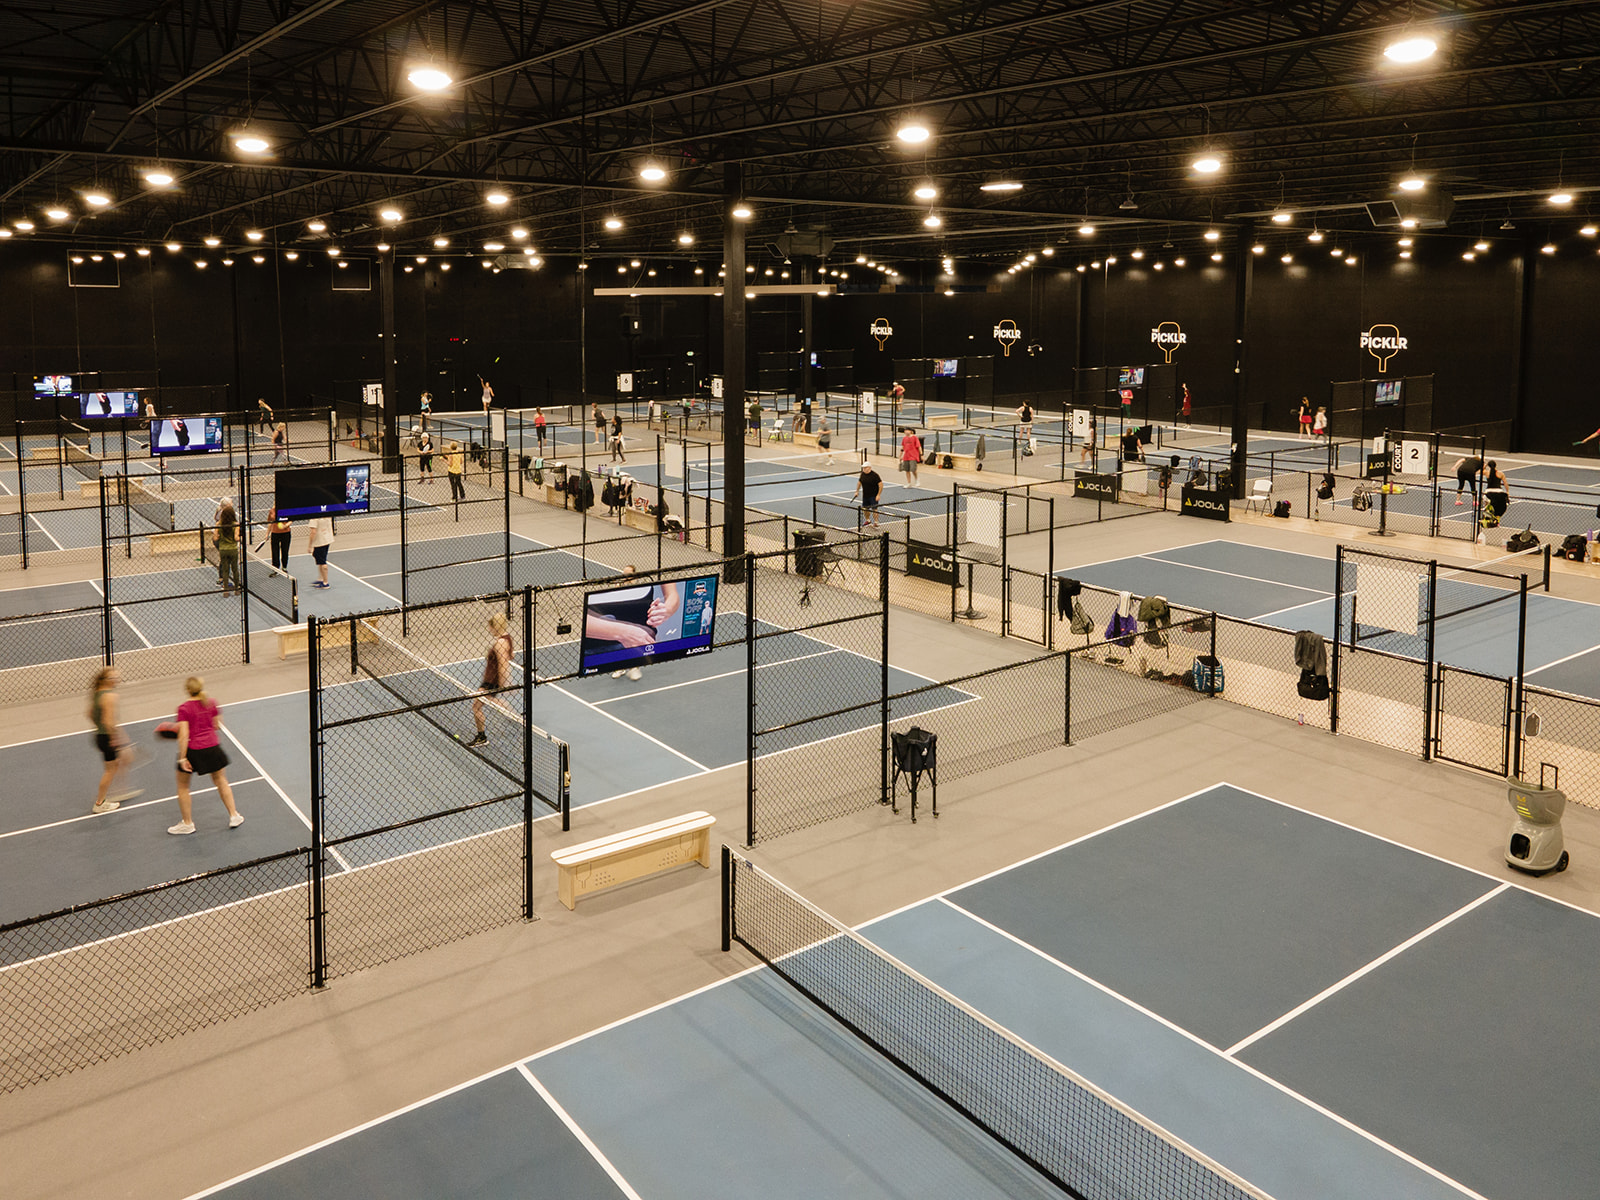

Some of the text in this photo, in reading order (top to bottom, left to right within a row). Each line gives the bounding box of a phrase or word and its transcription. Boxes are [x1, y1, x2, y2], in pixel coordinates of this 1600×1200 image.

[871, 327, 893, 335] PICKLR
[993, 329, 1022, 339] PICKLR
[1151, 332, 1187, 343] PICKLR
[1360, 336, 1408, 349] PICKLR
[1078, 415, 1084, 424] 3
[1394, 443, 1402, 469] COURT
[1410, 448, 1419, 459] 2
[1193, 499, 1225, 511] JOOLA
[920, 556, 953, 573] JOOLA
